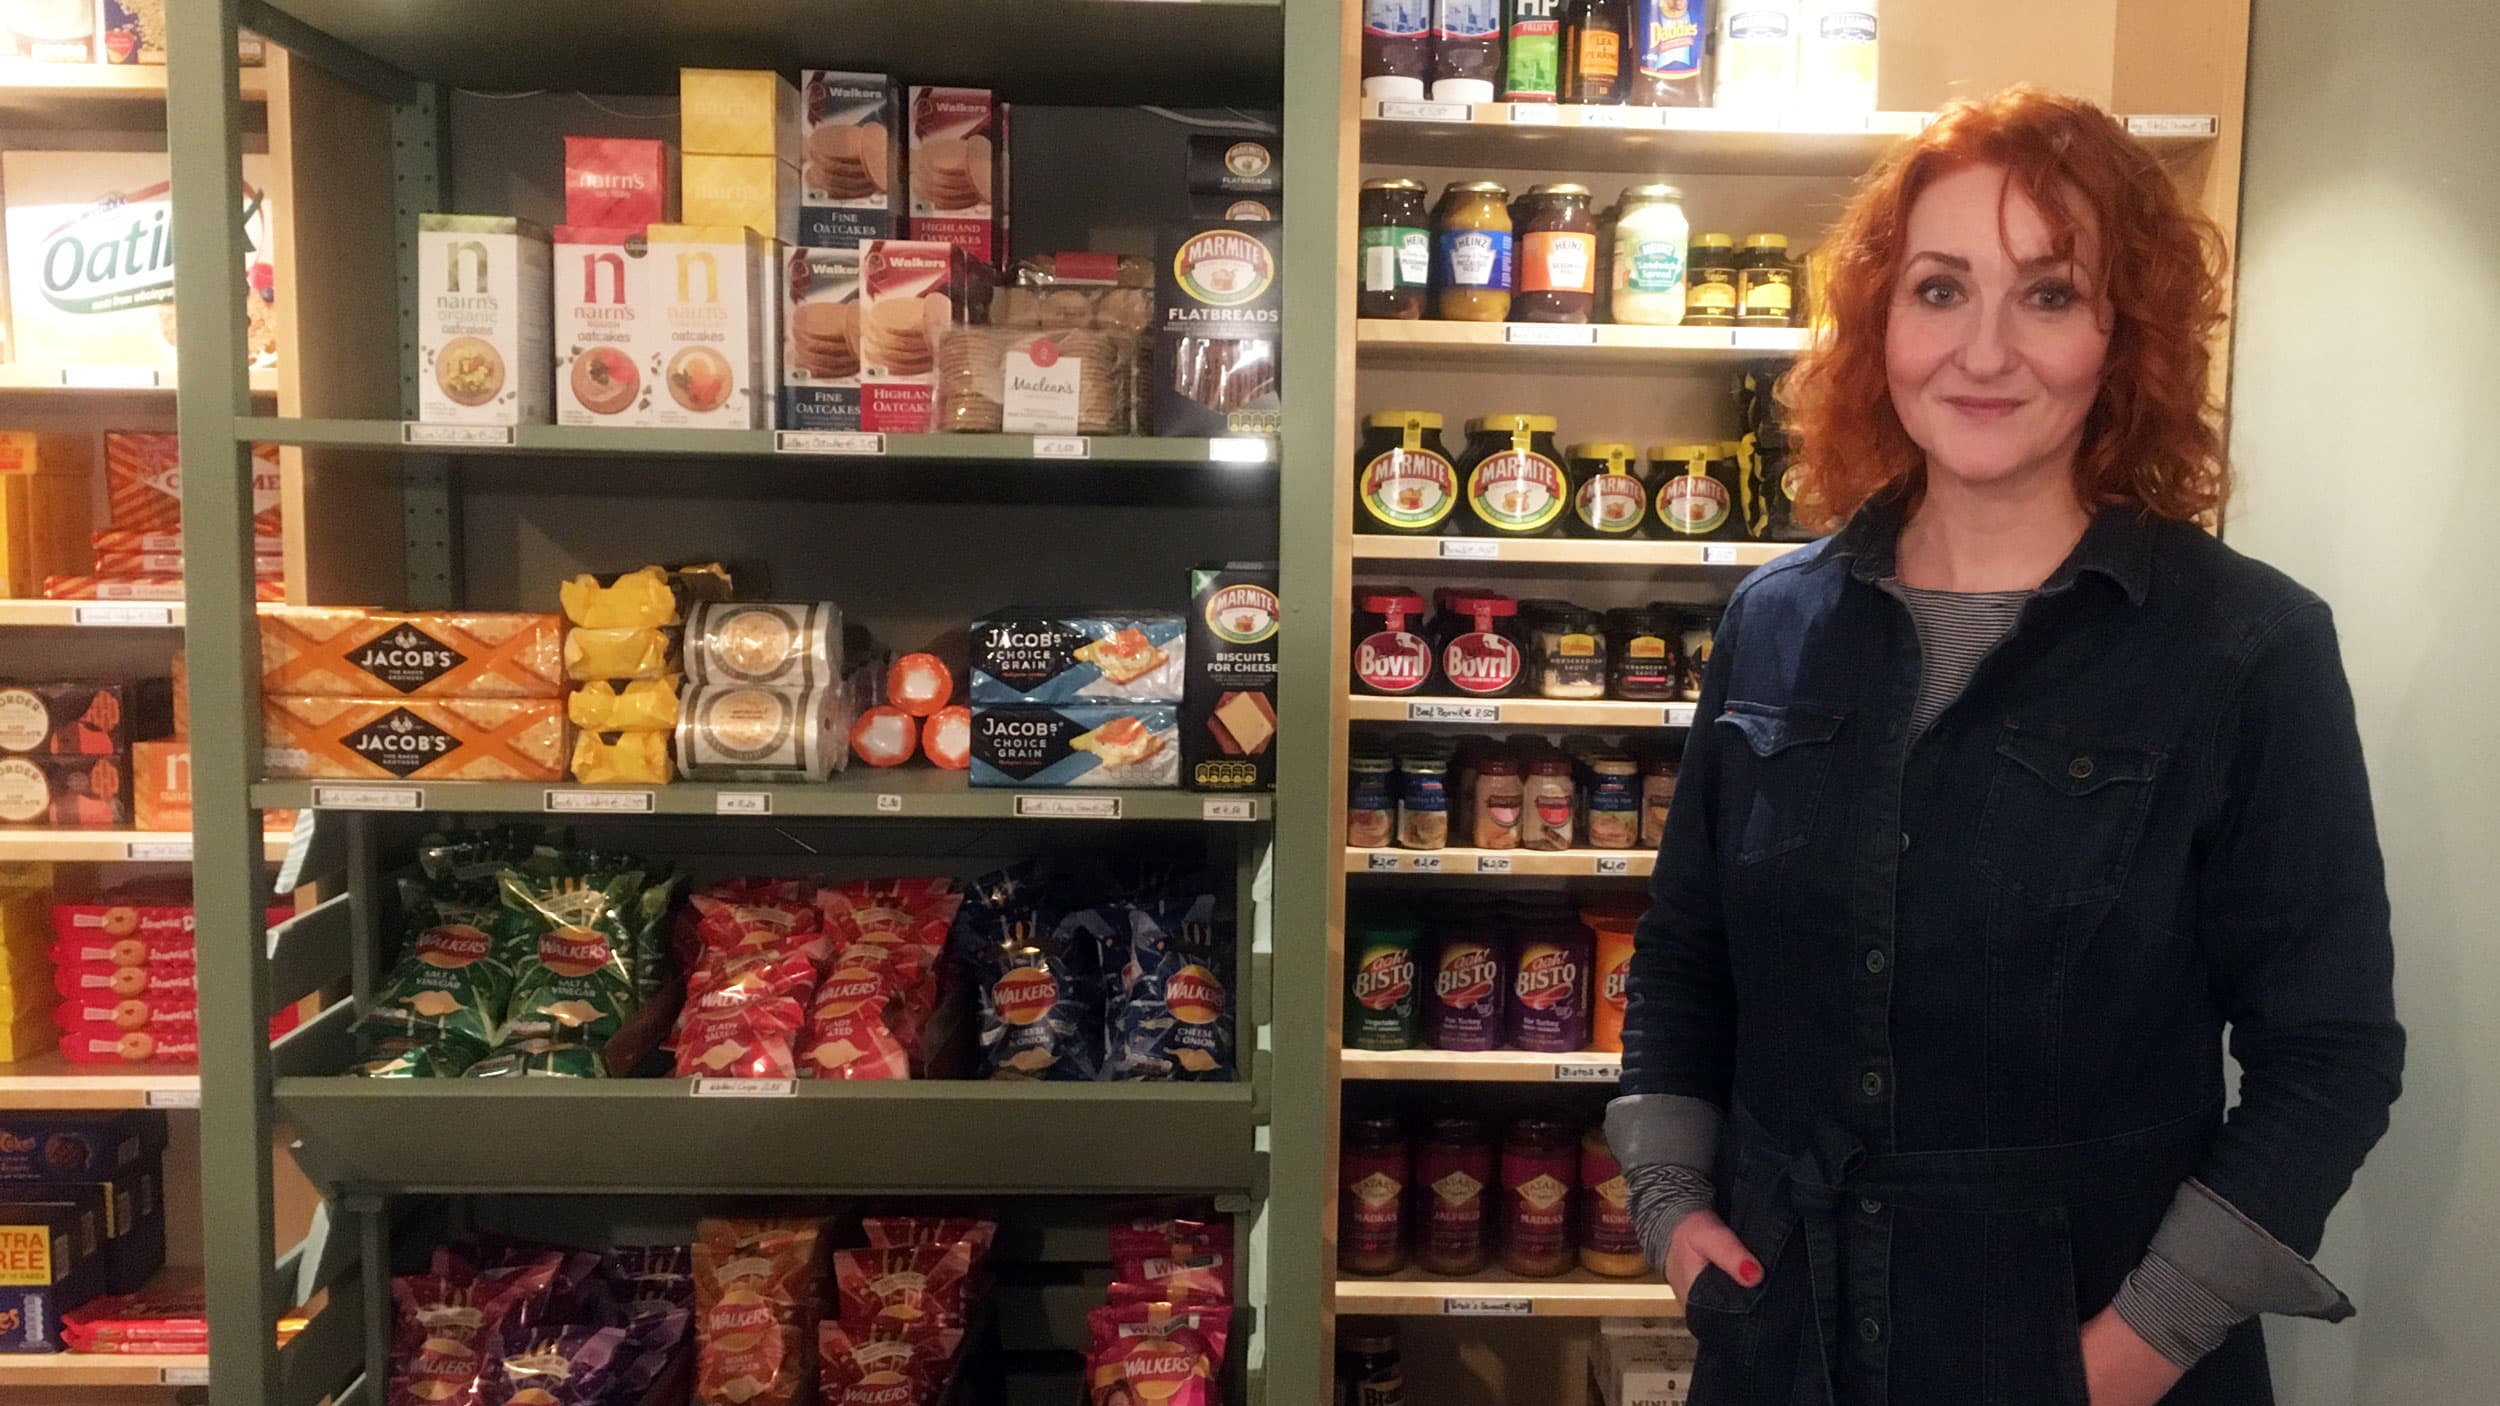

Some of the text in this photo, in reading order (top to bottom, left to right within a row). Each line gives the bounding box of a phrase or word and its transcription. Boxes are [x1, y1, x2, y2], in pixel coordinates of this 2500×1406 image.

[1522, 23, 1554, 32] FRUITY
[1596, 38, 1613, 46] LEA
[829, 87, 882, 98] Walkers
[936, 103, 987, 113] Walkers
[580, 171, 645, 189] nairn's
[832, 212, 858, 223] FINE
[813, 222, 877, 236] OATCAKES
[921, 222, 981, 233] HIGHLAND
[1459, 235, 1488, 247] HEINZ
[1187, 235, 1261, 264] MARMITE
[889, 256, 946, 269] Walkers
[812, 263, 859, 276] Walker
[437, 296, 499, 311] nairn's
[574, 306, 636, 321] nairn's
[1168, 308, 1279, 322] FLATBREADS
[815, 391, 842, 402] FINE
[873, 388, 930, 400] HIGHLAN
[795, 403, 861, 416] OATCAKES
[1375, 454, 1445, 482] MARMITE
[1482, 457, 1554, 486] MARMITE
[1586, 479, 1640, 496] MARMITE
[1667, 478, 1722, 497] MARMITE
[1217, 590, 1274, 611] MARMITE
[361, 650, 451, 667] JACOB'S
[996, 650, 1051, 660] CHOICE
[1216, 652, 1271, 662] BISCUITS
[1361, 644, 1424, 676] Bovril
[1001, 661, 1047, 670] GRAIN
[1207, 662, 1278, 673] FOR CHEESE
[1449, 646, 1512, 678] Bovril
[356, 735, 446, 751] JACOB'S
[993, 739, 1047, 748] CHOICE
[997, 749, 1042, 758] GRAIN
[540, 940, 607, 959] WALKERS
[425, 970, 448, 979] SALT
[1356, 961, 1415, 998] BISTO
[1437, 961, 1497, 996] BISTO
[1516, 963, 1577, 997] BISTO
[416, 978, 461, 990] VINEGAR
[558, 980, 581, 989] SALT
[551, 986, 596, 998] VINEGAR
[994, 982, 1057, 1005] WALKERS
[1177, 1027, 1213, 1039] CHEESE
[1017, 1035, 1050, 1046] ONION
[1182, 1036, 1216, 1048] ONION
[1154, 1262, 1186, 1275] WIN
[710, 1308, 771, 1330] WALKERS
[1124, 1356, 1191, 1375] WALKERS
[844, 1385, 910, 1403] WALKERS
